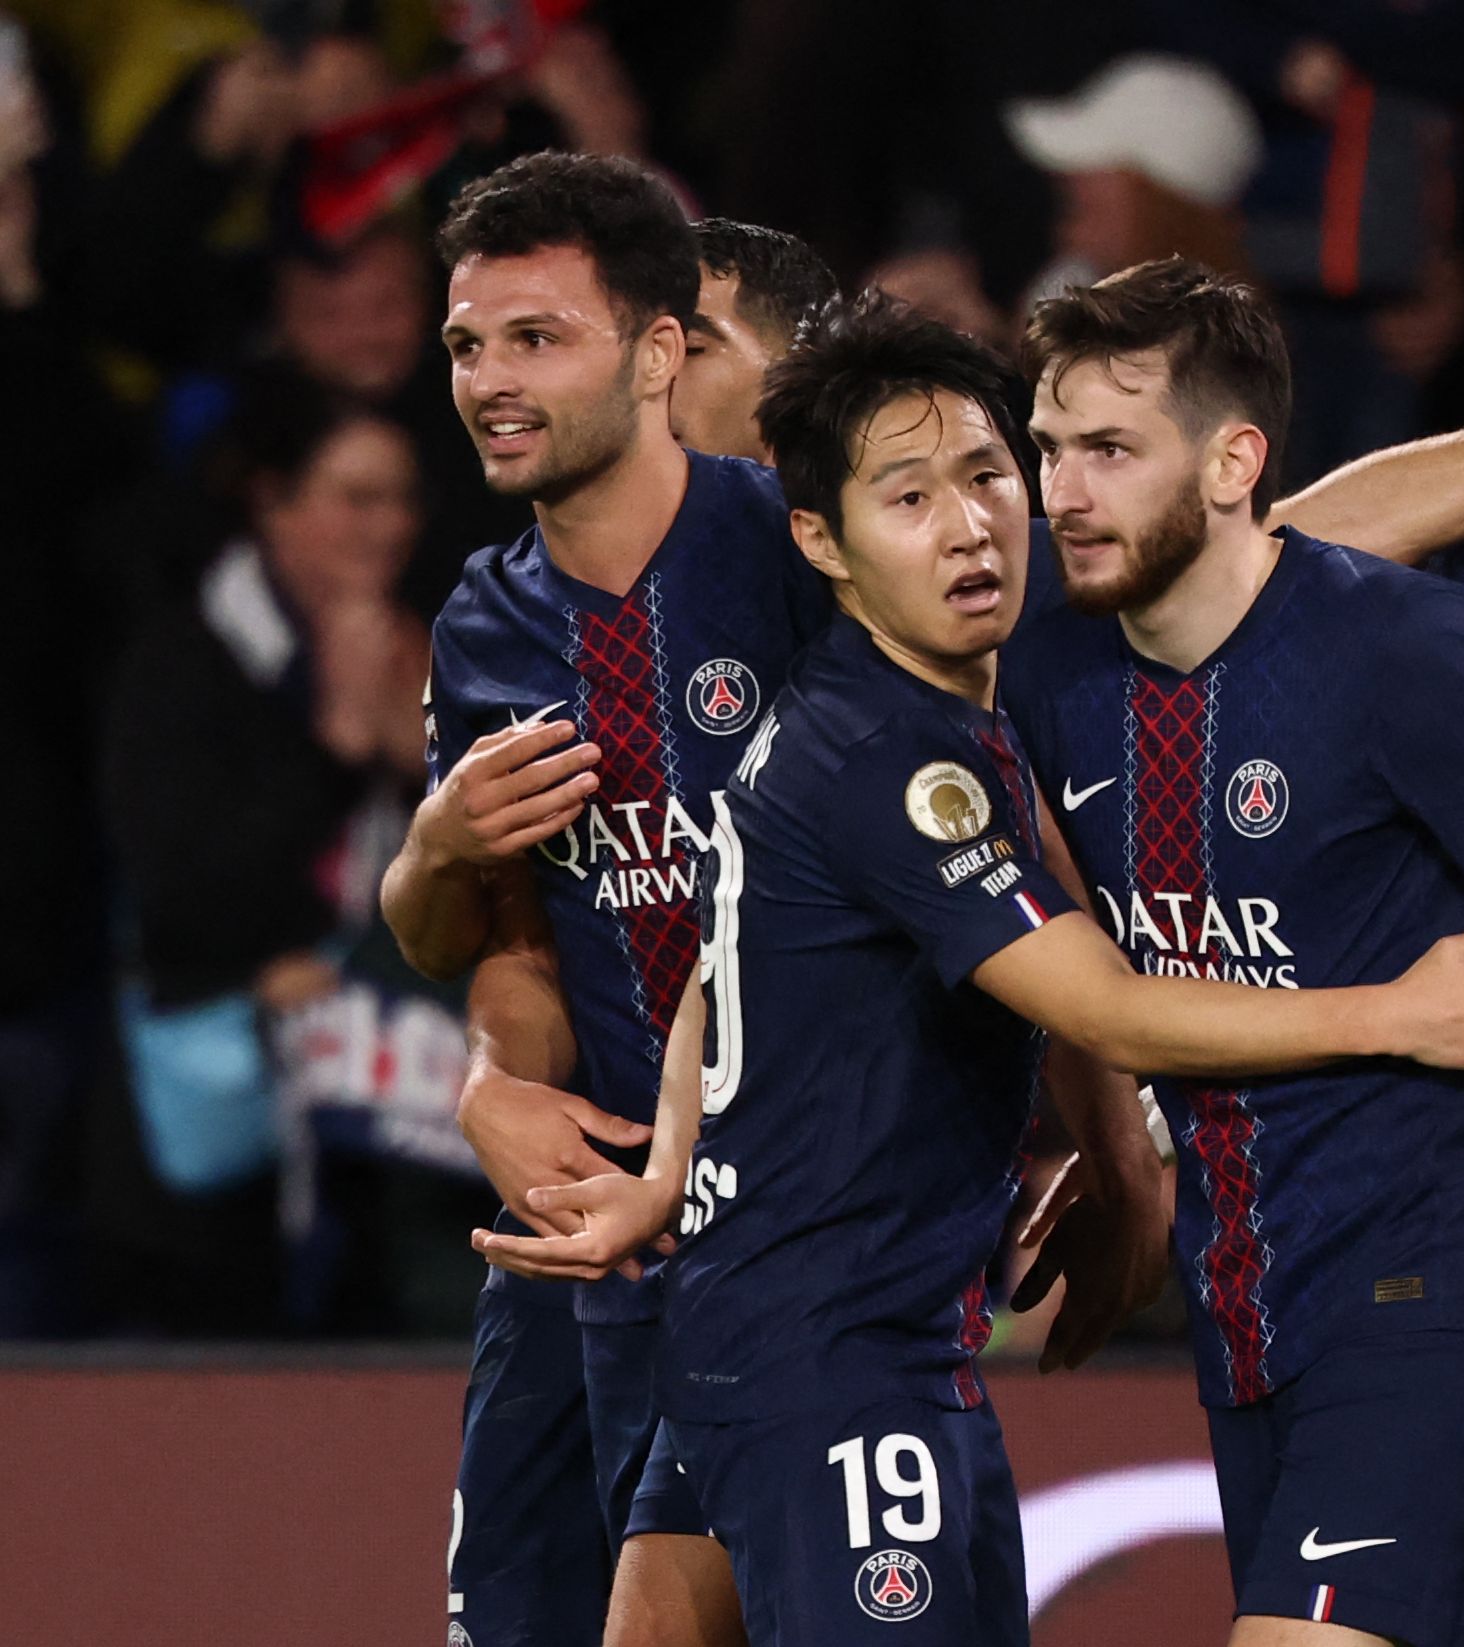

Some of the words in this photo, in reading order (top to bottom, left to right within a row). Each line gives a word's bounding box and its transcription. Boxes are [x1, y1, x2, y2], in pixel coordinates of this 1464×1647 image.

[696, 662, 743, 685] PARIS
[1238, 763, 1279, 783] PARIS
[537, 790, 728, 881] QATA
[595, 860, 697, 910] AIRW
[827, 1432, 942, 1549] 19
[866, 1553, 918, 1573] PARIS
